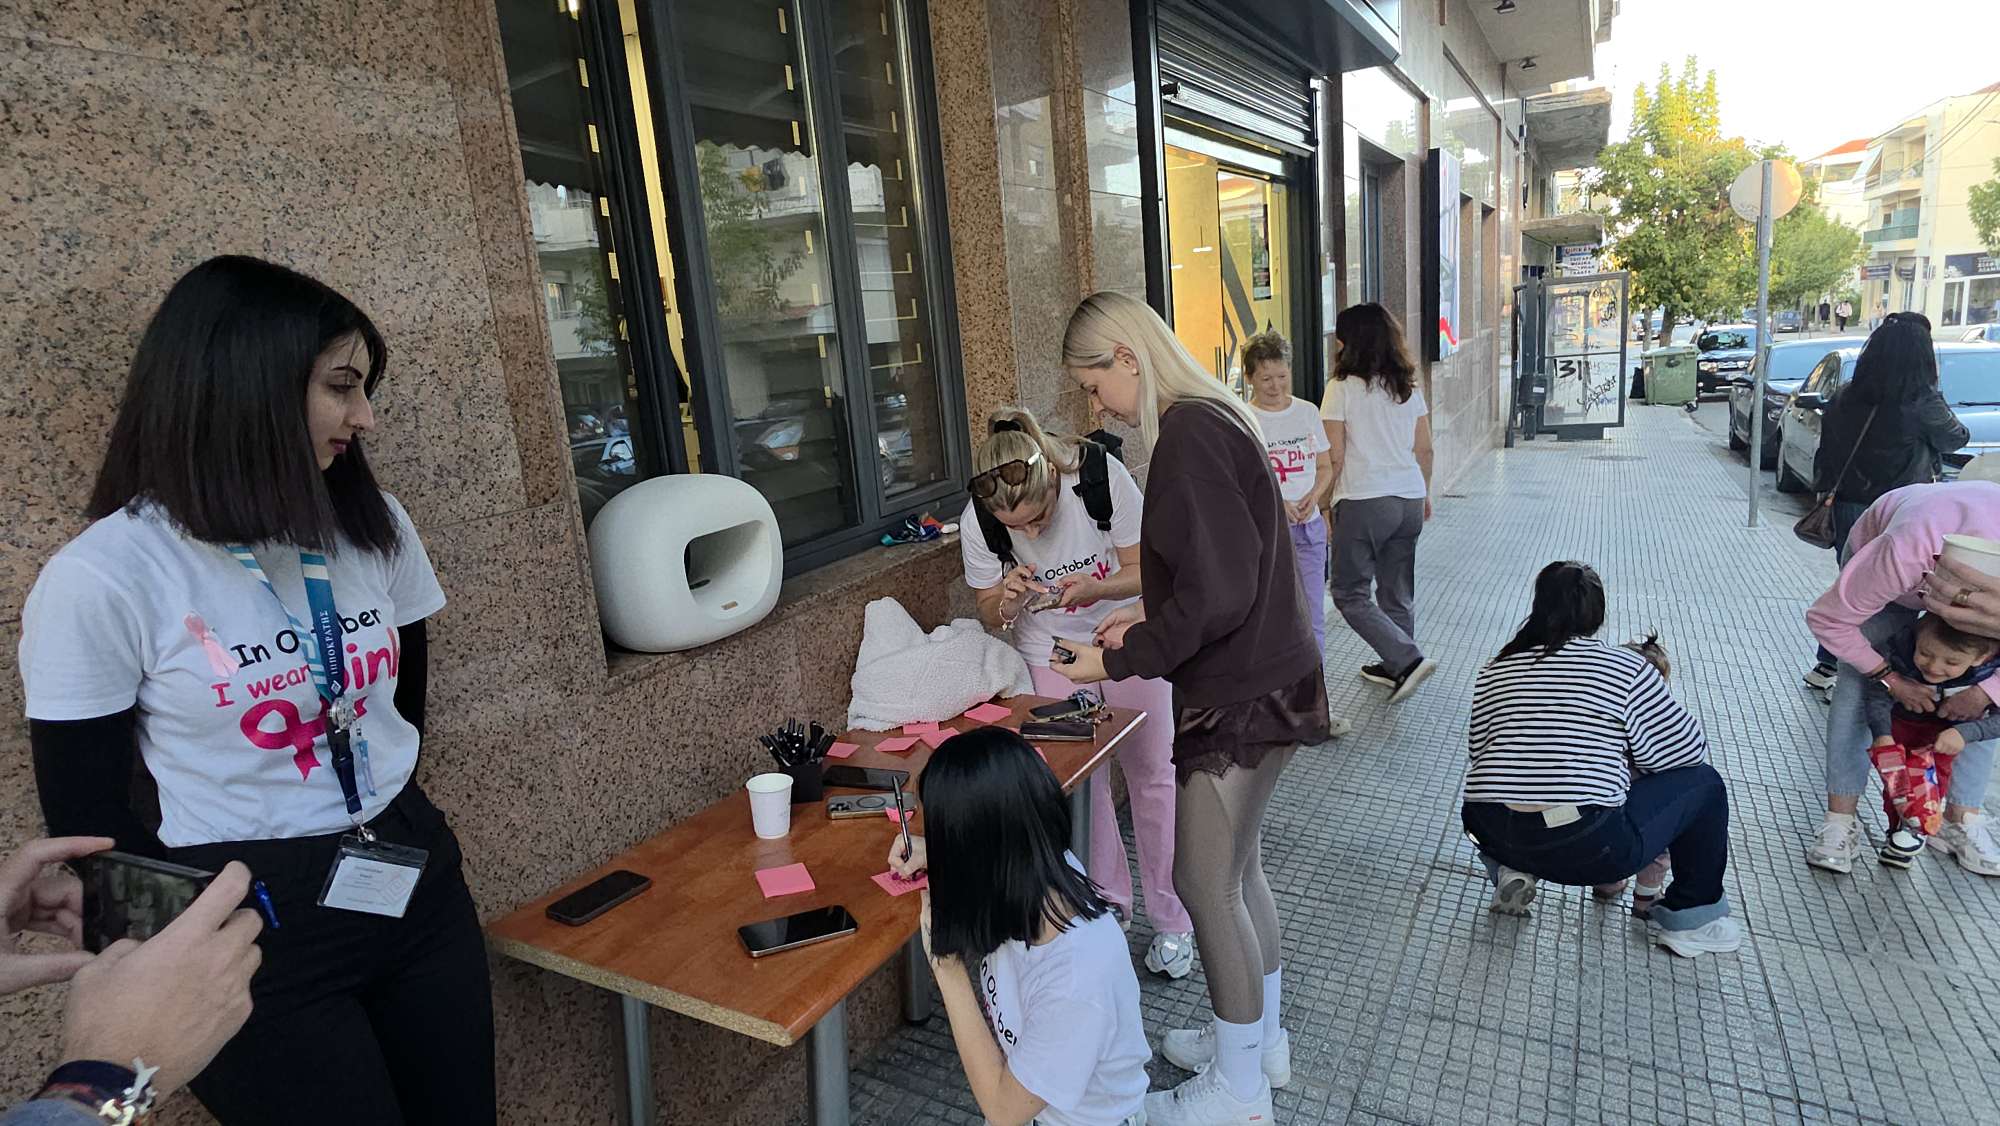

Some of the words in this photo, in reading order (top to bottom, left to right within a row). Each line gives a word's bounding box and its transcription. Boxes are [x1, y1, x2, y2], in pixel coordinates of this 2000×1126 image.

[1032, 575, 1043, 583] n
[1045, 553, 1098, 581] October
[230, 643, 272, 669] In
[275, 607, 381, 655] Ober
[210, 682, 235, 708] I
[246, 663, 310, 700] wear
